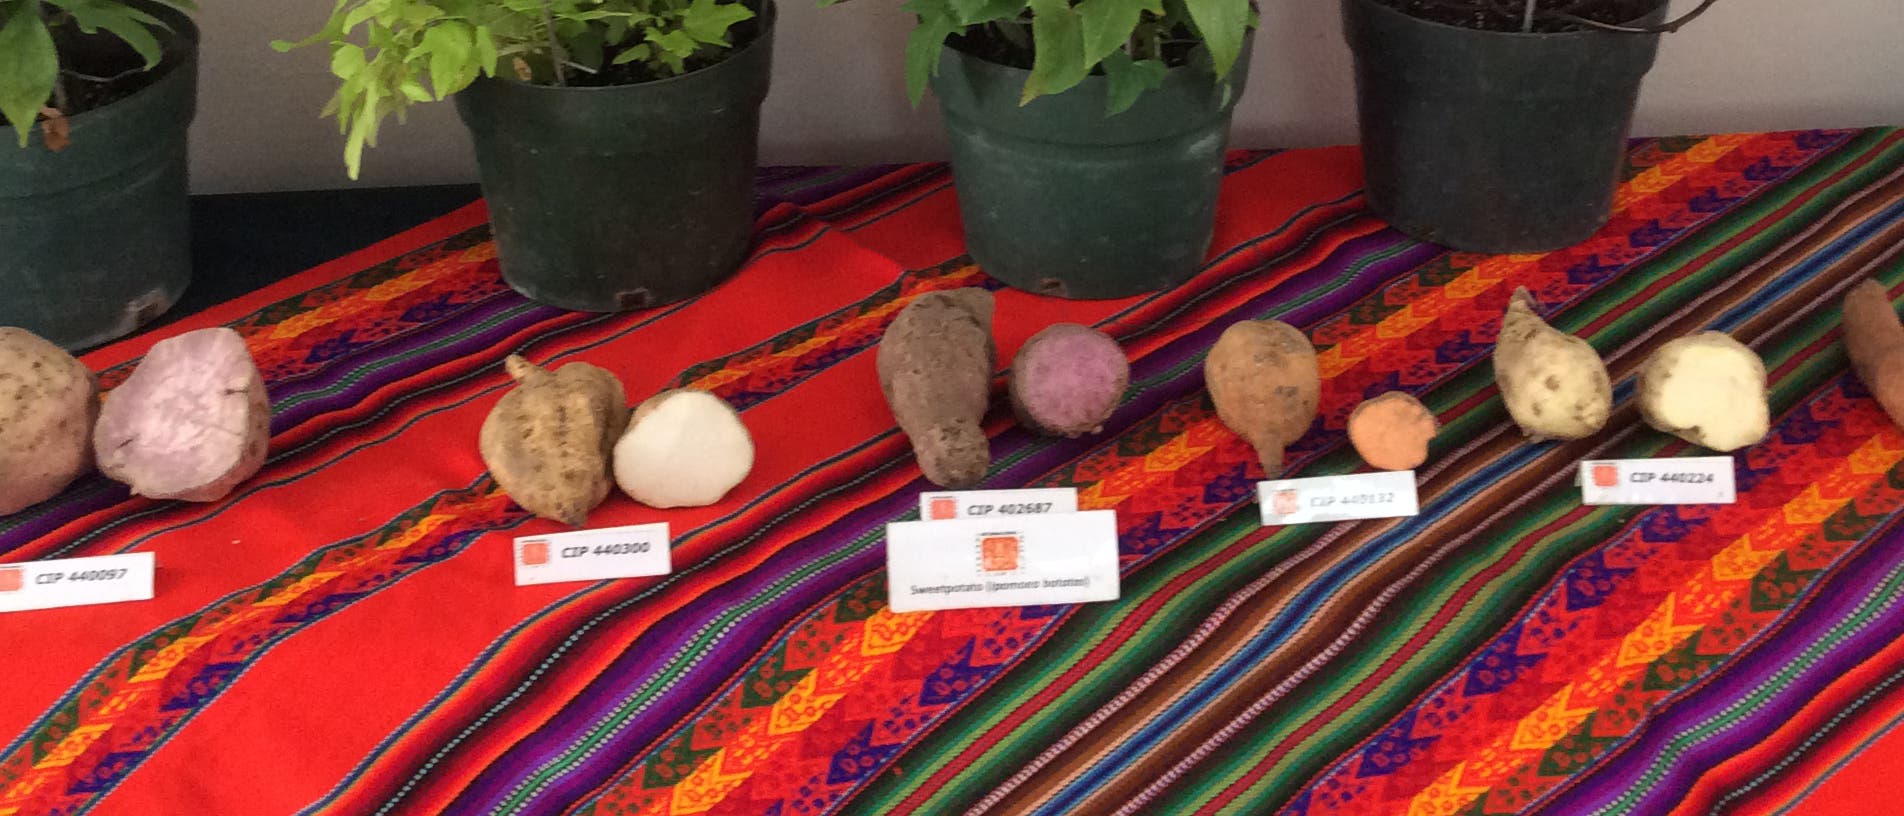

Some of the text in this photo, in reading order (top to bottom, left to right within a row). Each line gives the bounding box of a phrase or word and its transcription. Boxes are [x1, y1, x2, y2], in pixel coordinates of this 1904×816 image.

[1630, 472, 1656, 483] CIP
[967, 502, 1053, 516] CIP 402687
[561, 542, 651, 558] CIP 440300
[35, 568, 129, 584] CIP 440097
